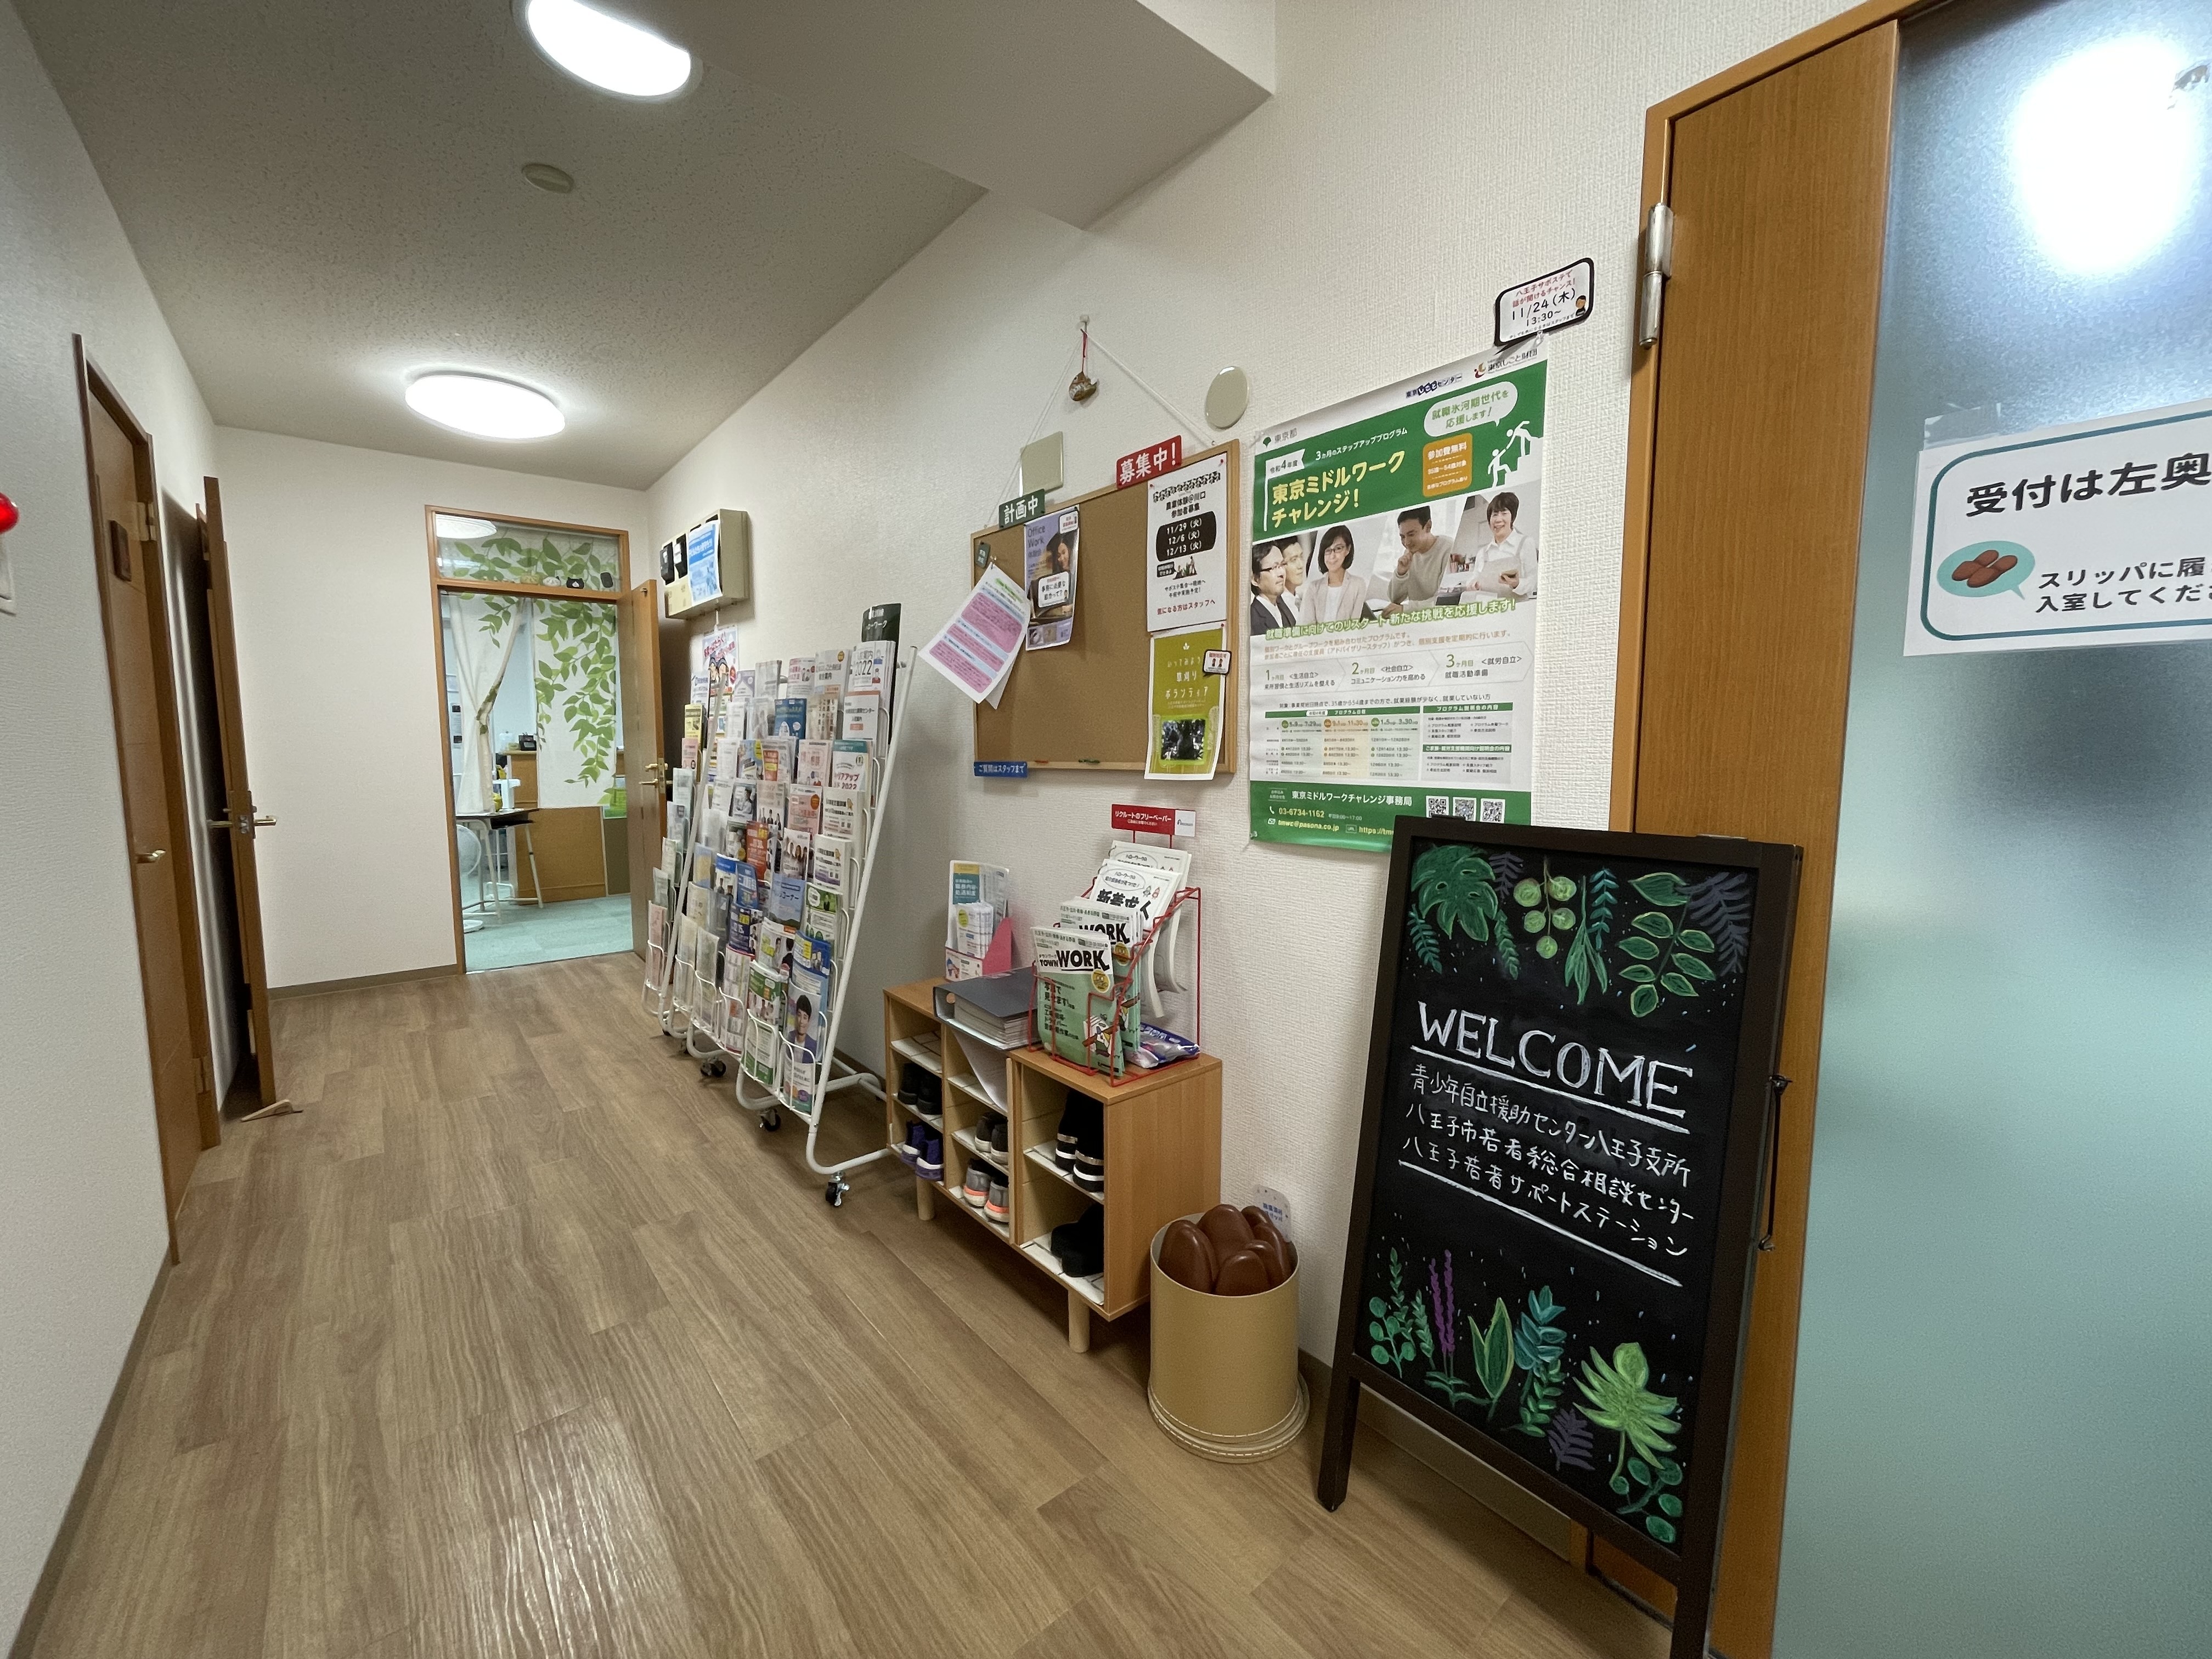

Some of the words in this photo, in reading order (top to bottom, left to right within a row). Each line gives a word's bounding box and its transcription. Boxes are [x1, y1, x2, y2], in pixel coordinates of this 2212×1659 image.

[1432, 390, 1509, 420] 就職氷河期世代を
[1272, 450, 1405, 505] 東京ミドルワーク
[1966, 453, 2211, 517] 受付は左奥
[1004, 495, 1039, 524] 計画中
[1027, 525, 1045, 538] Office
[1027, 538, 1045, 549] Work
[2038, 556, 2212, 589] スリッパに履
[1157, 599, 1215, 615] 気になる方はスタッフへ
[1176, 670, 1197, 681] 草刈り
[1165, 686, 1208, 699] ボランティア
[1292, 791, 1413, 806] 東京ミドルワークチャレンジ事務局
[1278, 807, 1325, 818] 03-6734-1162
[1278, 820, 1340, 831] tmwc@pasona.co.jp
[1040, 959, 1059, 967] TOWN
[1056, 950, 1110, 971] WORK
[1418, 1001, 1694, 1119] WELCOME
[1410, 1063, 1691, 1188] 青少年自立援助センター八王子支所
[1406, 1103, 1694, 1224] 八王子市若者総合相談センター
[1403, 1137, 1688, 1256] 八王子若者サポートステーション
